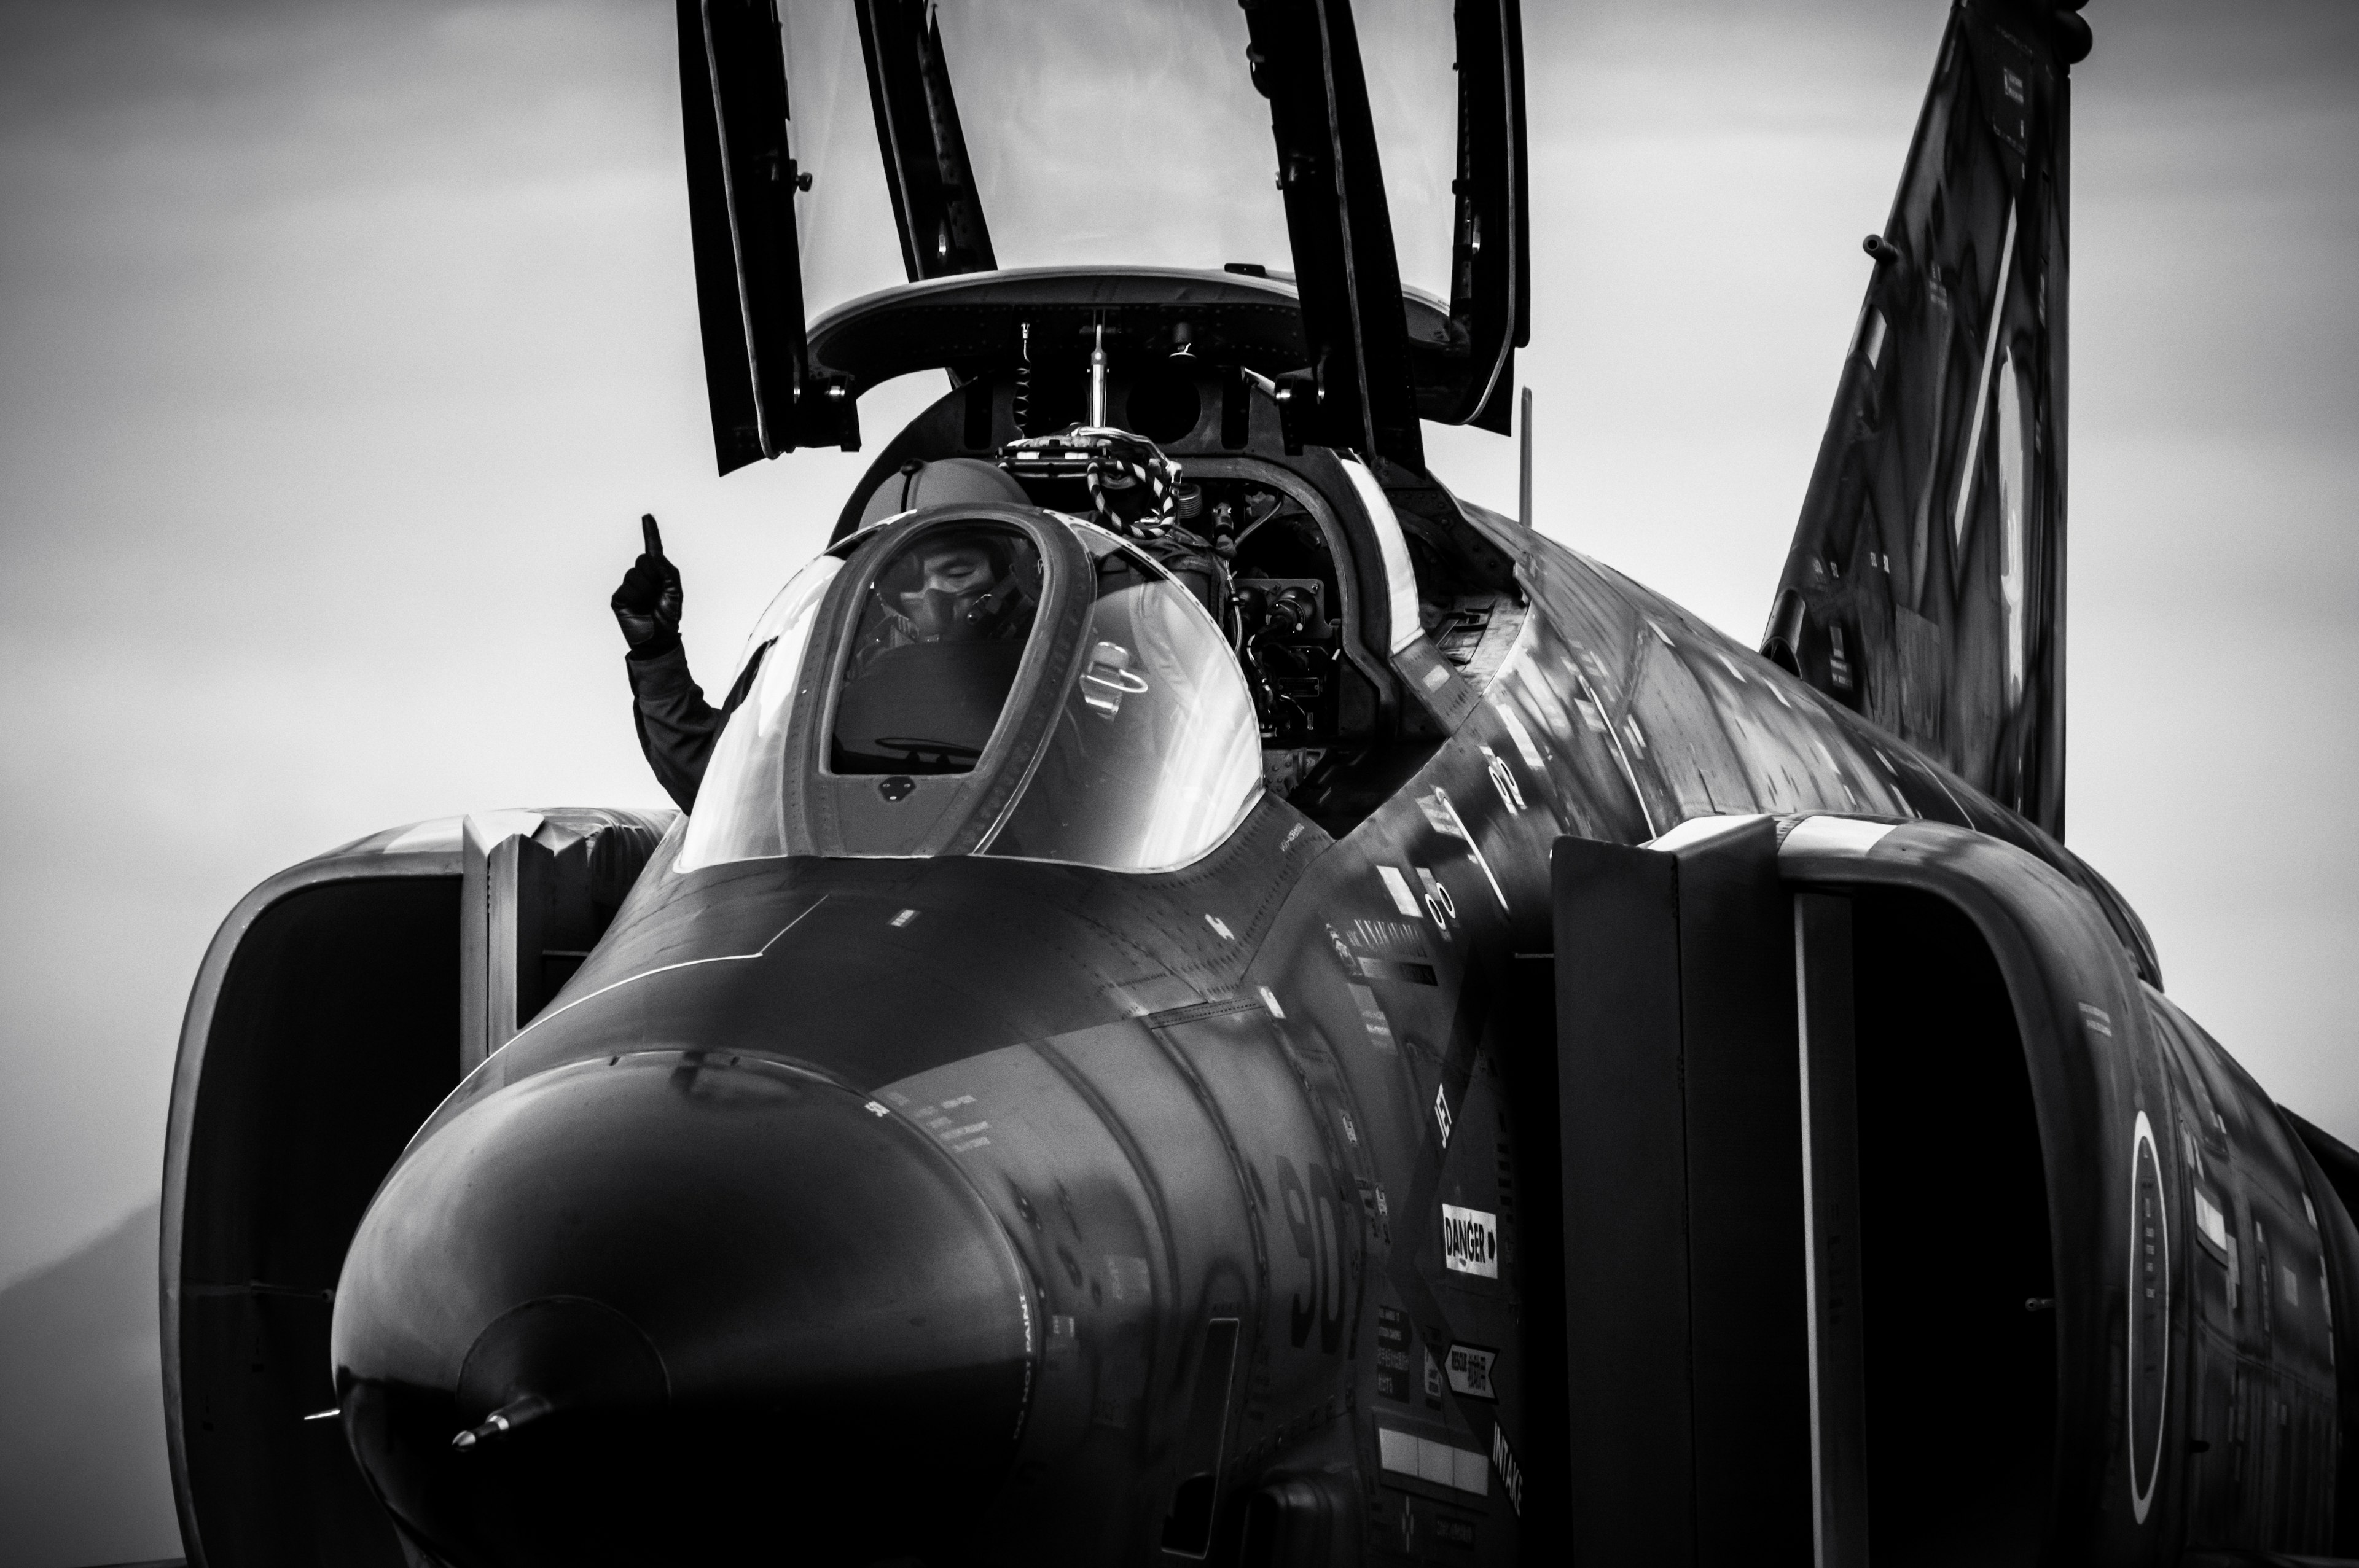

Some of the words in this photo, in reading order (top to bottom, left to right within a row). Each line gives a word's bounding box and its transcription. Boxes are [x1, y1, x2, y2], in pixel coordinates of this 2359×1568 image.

[1434, 1082, 1452, 1149] JET
[1444, 1217, 1485, 1263] DANGER
[1019, 1292, 1032, 1354] PAINT
[1022, 1359, 1031, 1403] NOT
[1451, 1350, 1468, 1373] RESCUE
[1012, 1409, 1025, 1440] DO
[1493, 1421, 1524, 1518] INTAKE
